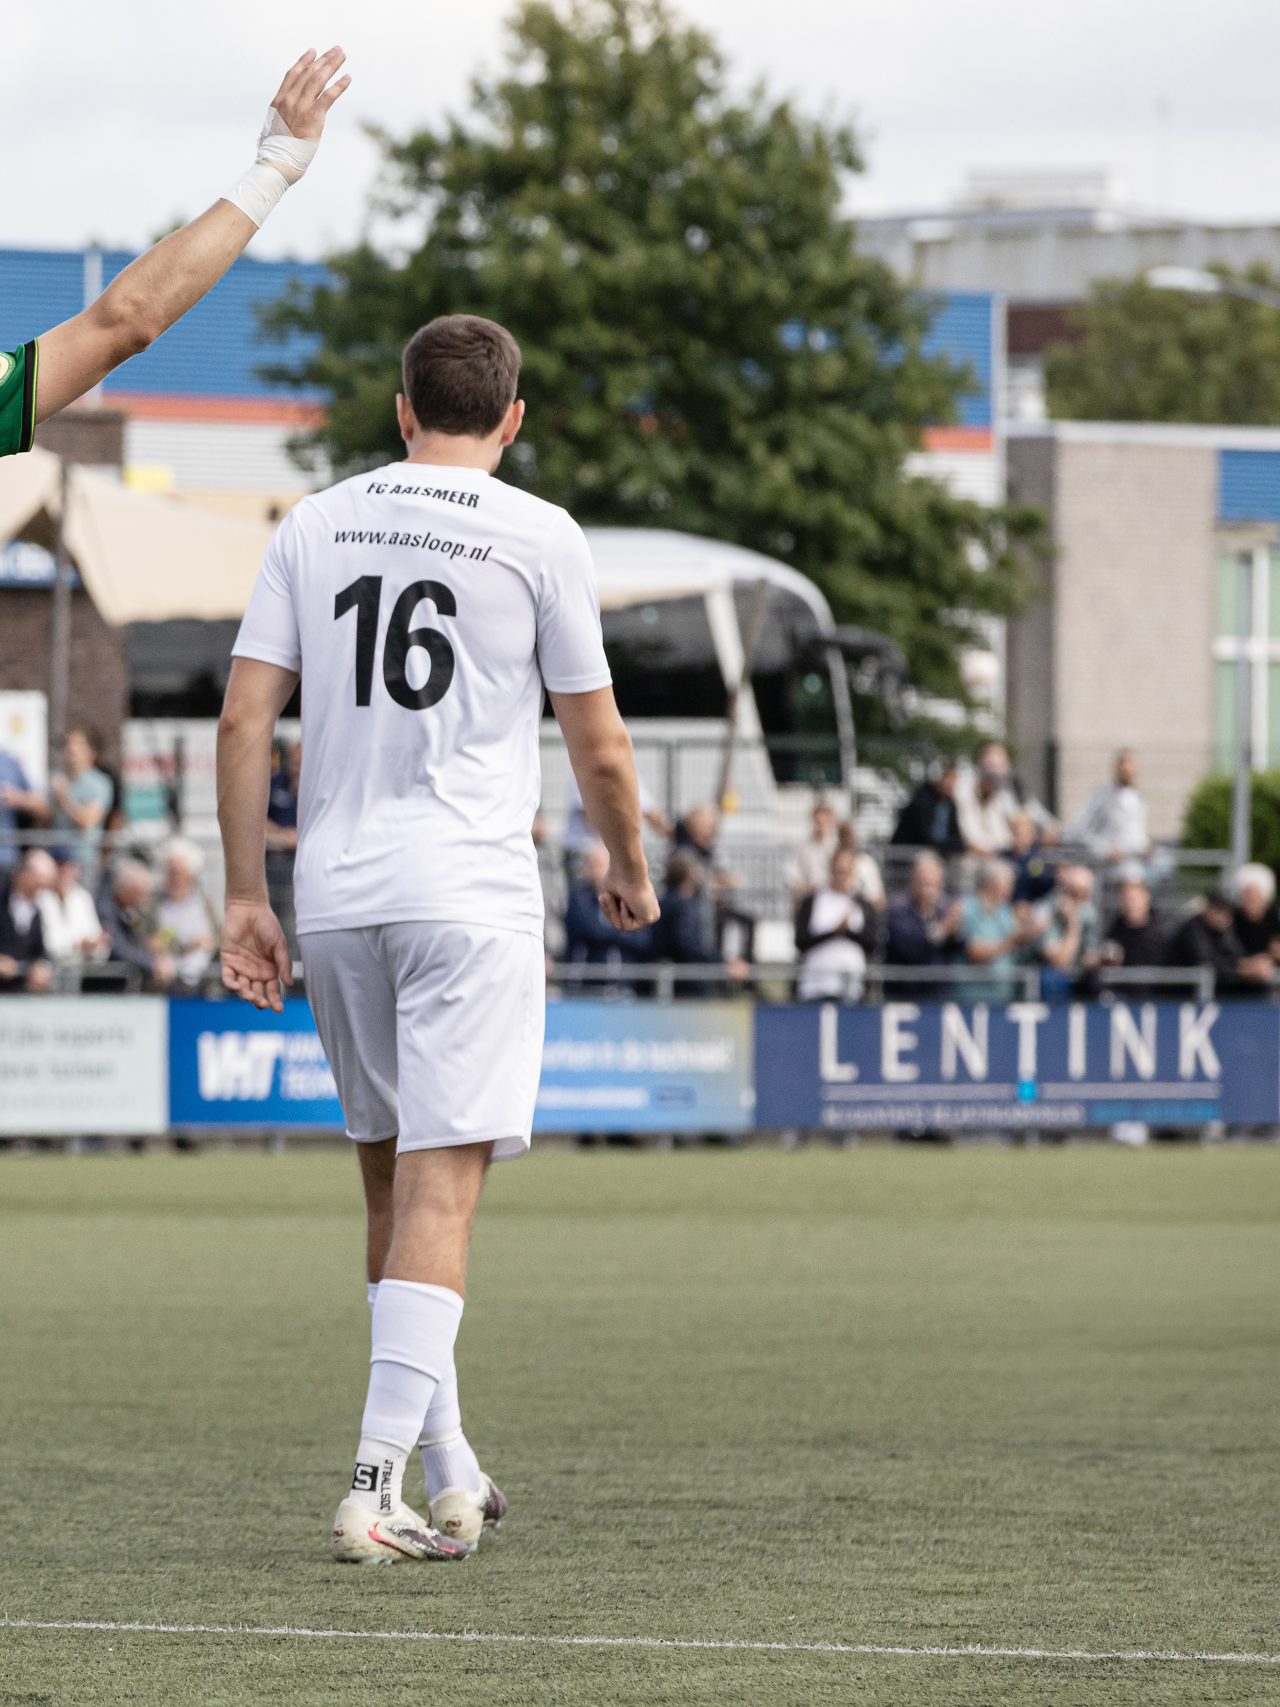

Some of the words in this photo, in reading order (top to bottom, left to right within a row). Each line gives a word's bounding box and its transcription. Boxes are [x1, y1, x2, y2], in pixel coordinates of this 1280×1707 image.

[366, 482, 388, 494] FC
[389, 484, 480, 508] AALSMEER
[334, 529, 492, 562] www.aasloop.nl
[334, 575, 457, 711] 16
[820, 1001, 1221, 1082] LENTINK
